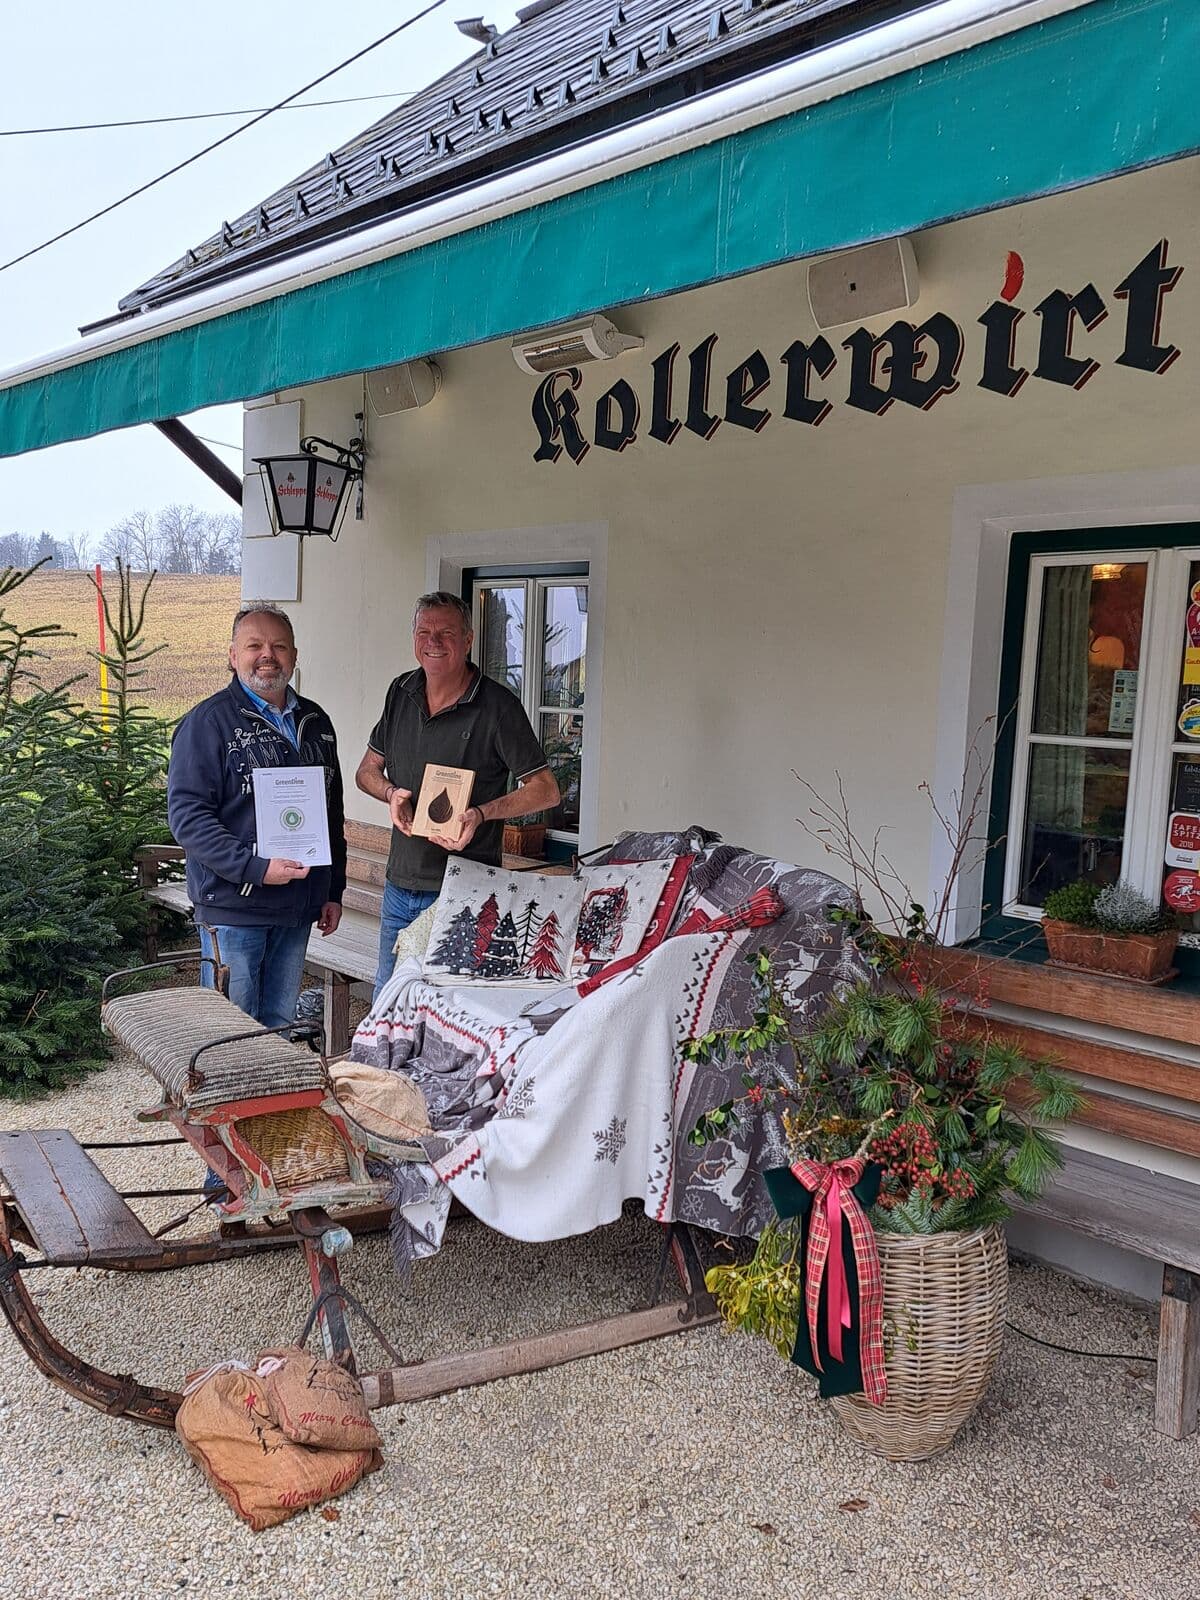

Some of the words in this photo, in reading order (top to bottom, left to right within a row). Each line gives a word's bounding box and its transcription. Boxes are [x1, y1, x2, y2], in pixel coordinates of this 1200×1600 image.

[531, 237, 1184, 465] Kollerwirt
[299, 1411, 337, 1426] Merry
[278, 1487, 322, 1507] Merry
